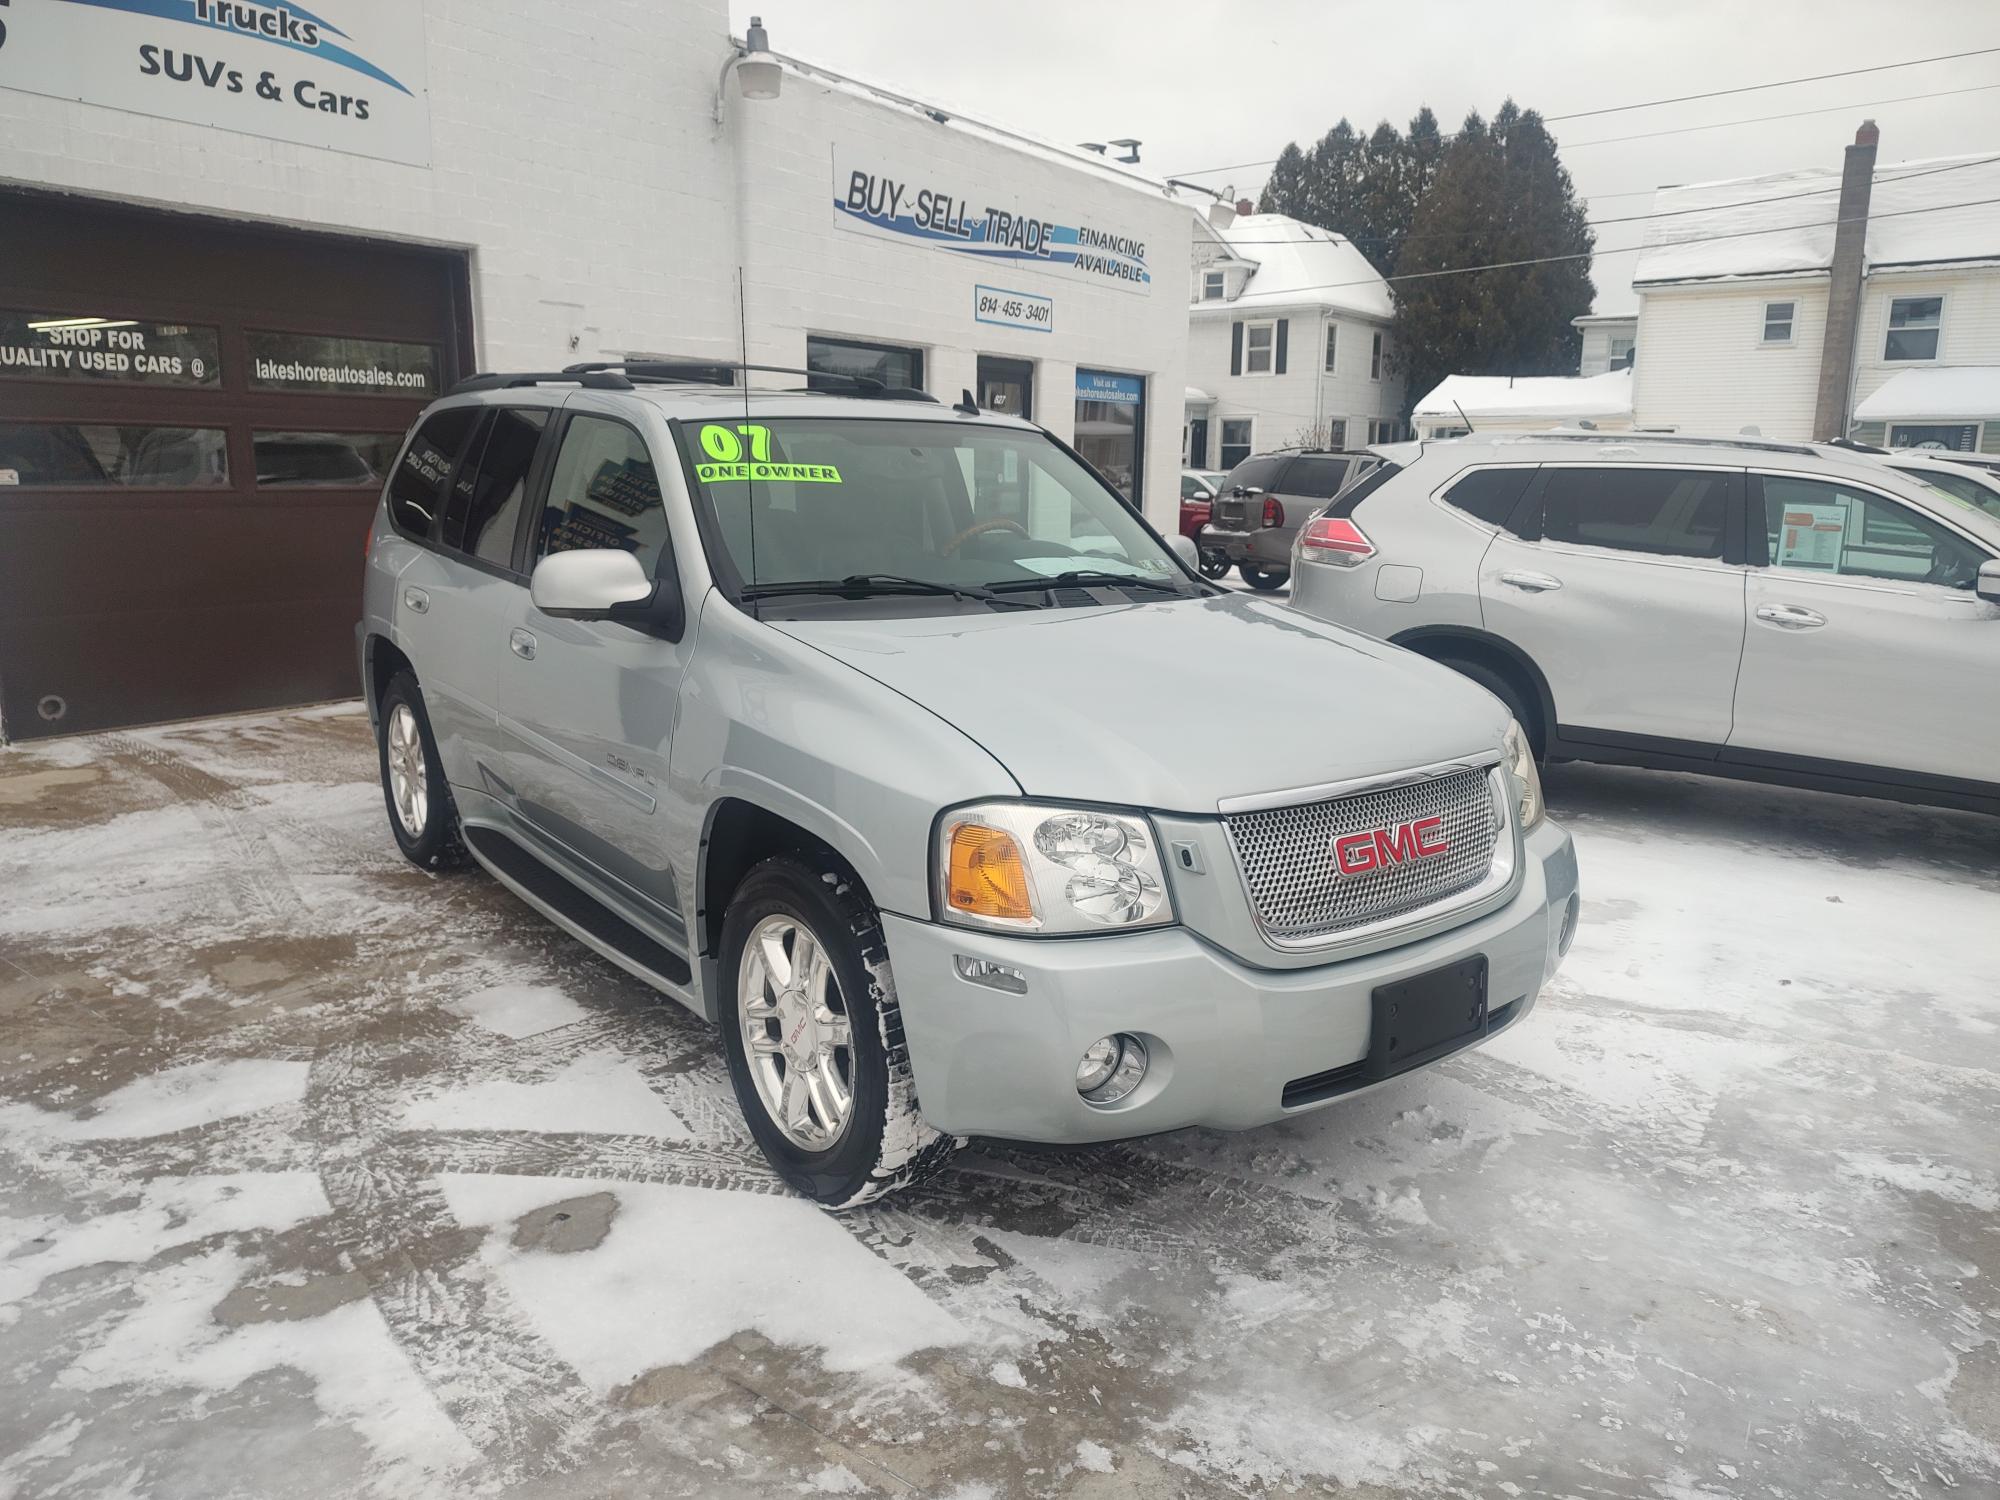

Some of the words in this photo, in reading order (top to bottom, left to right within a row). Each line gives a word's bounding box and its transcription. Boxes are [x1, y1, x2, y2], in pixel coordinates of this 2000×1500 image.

[195, 0, 318, 46] Trucks
[139, 44, 243, 93] SUVs
[255, 71, 284, 102] &
[293, 80, 370, 120] Cars
[847, 170, 905, 219] BUY
[915, 189, 970, 237] SELL
[985, 207, 1054, 256] TRADE
[1078, 227, 1145, 258] FINANCING
[1074, 253, 1143, 282] AVAILABLE
[50, 328, 102, 347] SHOP
[108, 330, 146, 350] FOR
[0, 346, 73, 368] UALITY
[79, 350, 130, 372] USED
[134, 354, 183, 375] CARS
[191, 358, 205, 378] @
[256, 358, 426, 388] lakeshoreautosales.com
[700, 424, 771, 463] 07
[700, 465, 749, 479] ONE
[755, 464, 837, 480] OWNER
[1330, 815, 1449, 878] GMC
[790, 1016, 807, 1045] GMC
